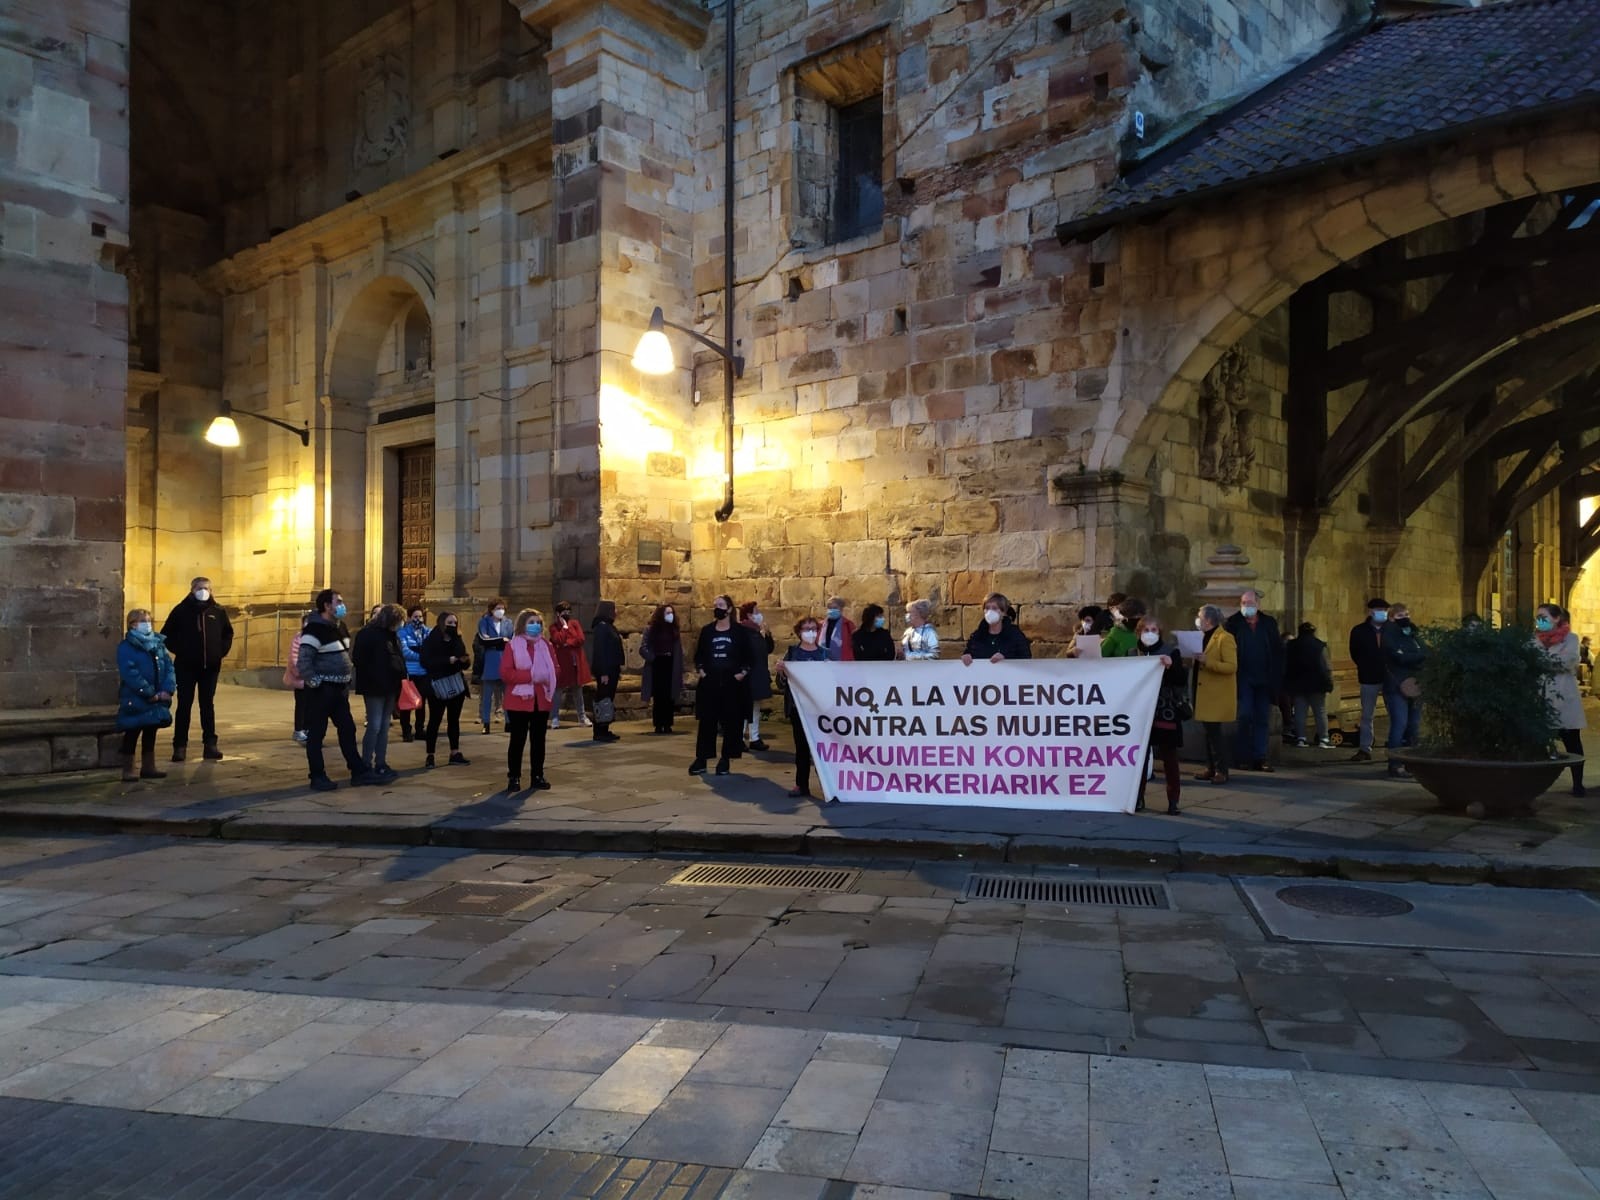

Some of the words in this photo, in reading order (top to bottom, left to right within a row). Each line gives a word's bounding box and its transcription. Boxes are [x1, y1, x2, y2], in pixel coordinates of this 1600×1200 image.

[835, 686, 880, 714] NO
[884, 686, 903, 706] A
[912, 685, 945, 706] LA
[953, 683, 1106, 706] VIOLENCIA
[817, 714, 927, 737] CONTRA
[936, 715, 988, 737] LAS
[997, 713, 1131, 737] MUJERES
[816, 742, 975, 767] MAKUMEEN
[838, 769, 1060, 796] INDARKERIARIK
[1069, 774, 1107, 796] EZ
